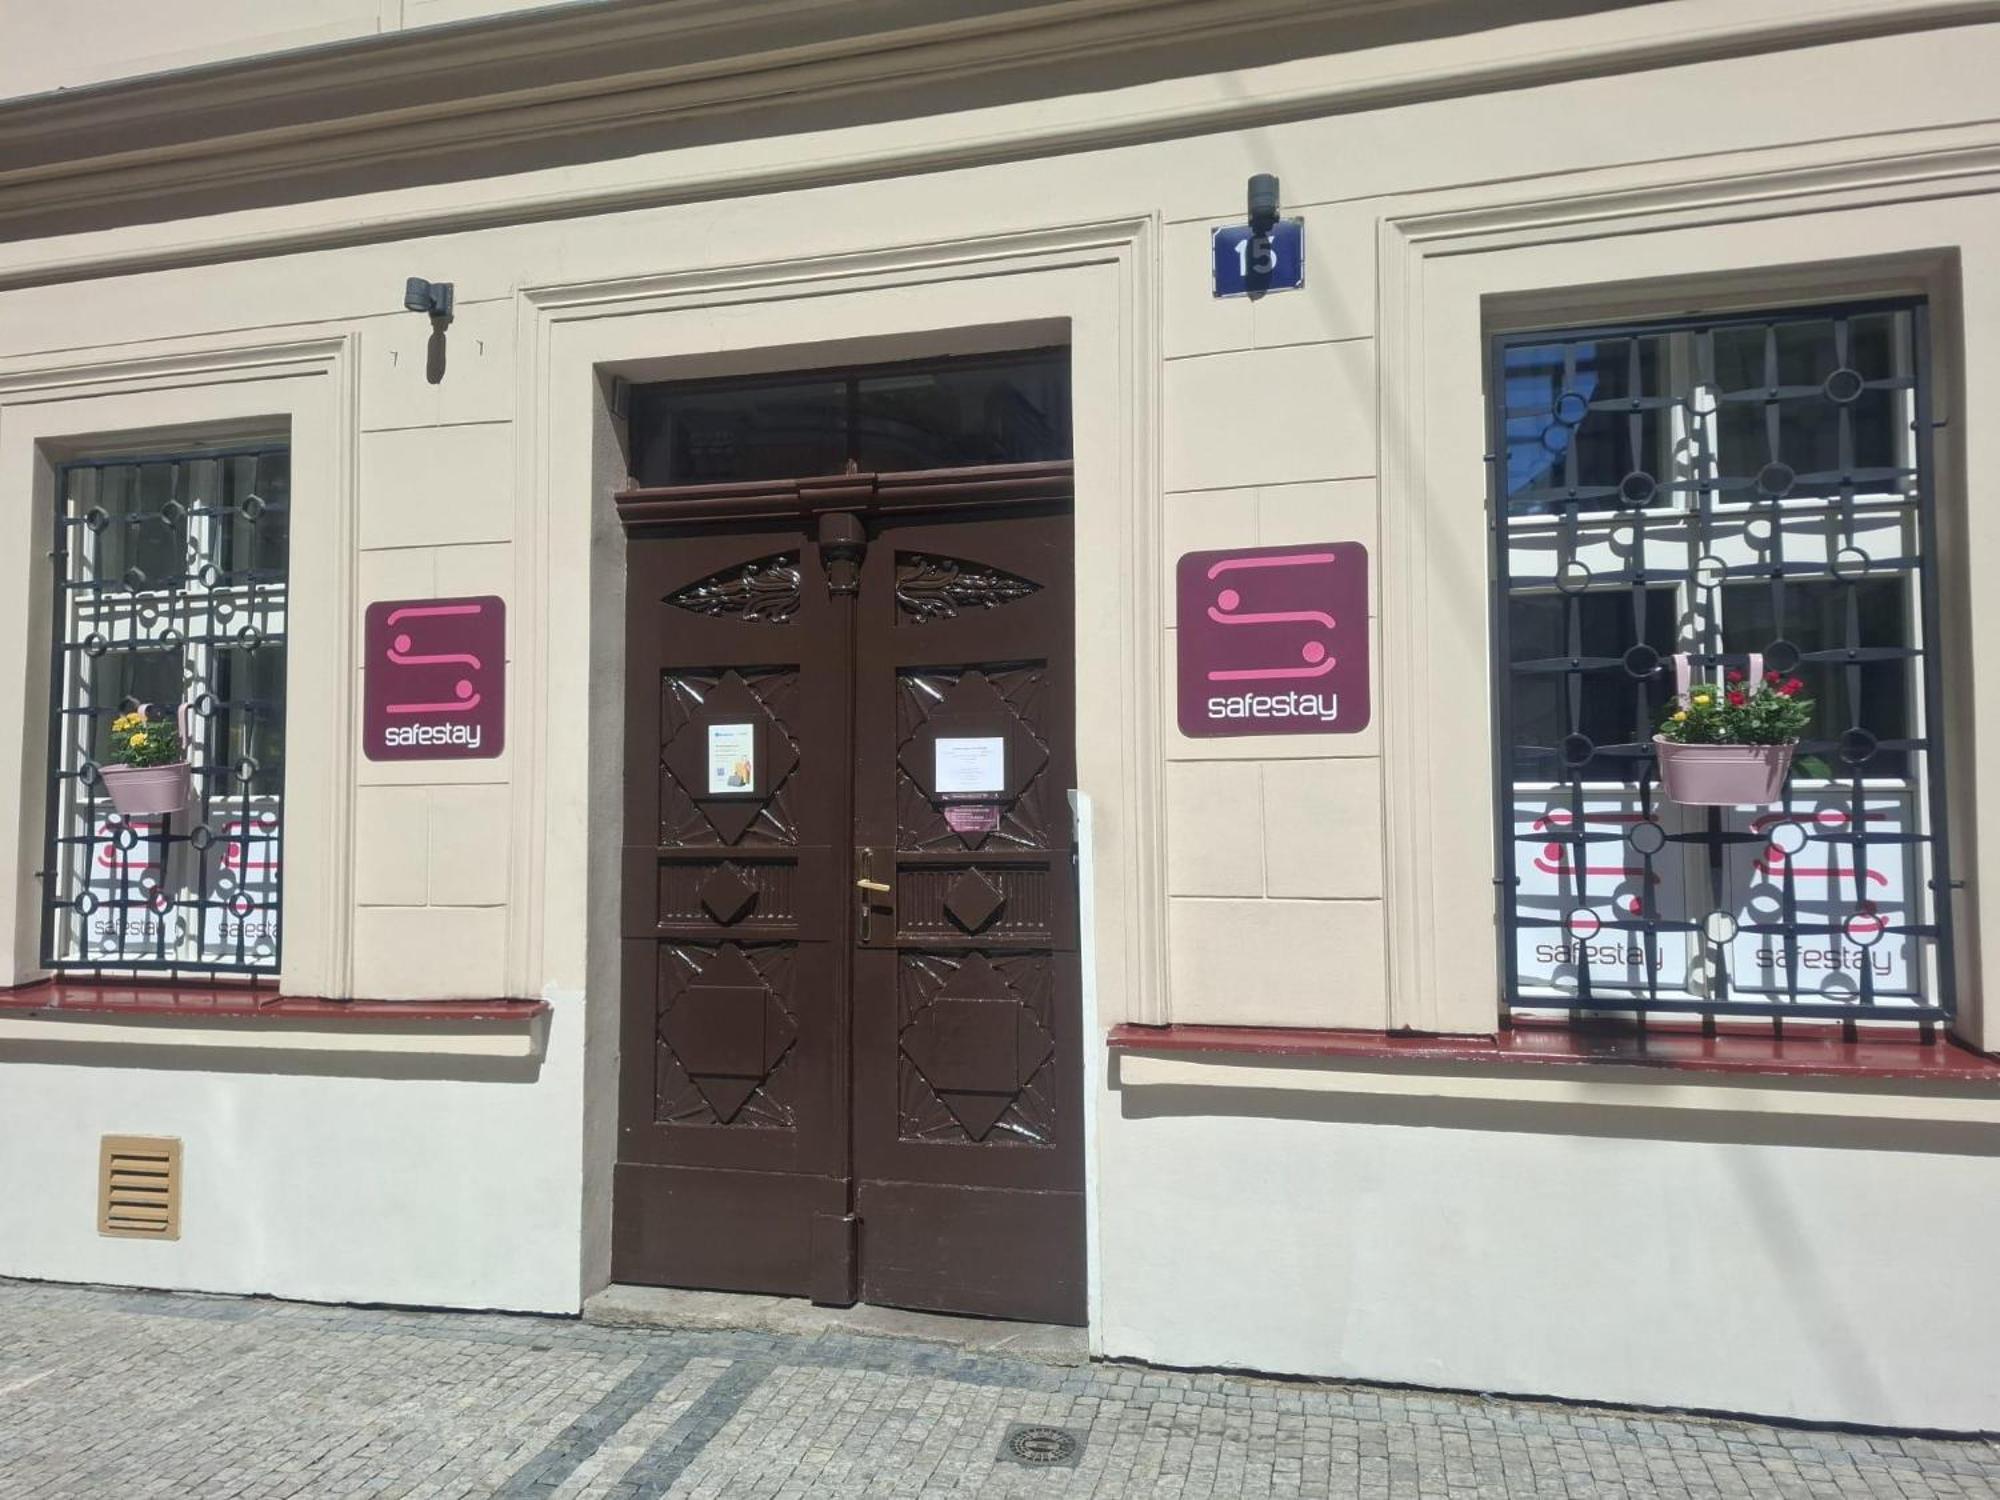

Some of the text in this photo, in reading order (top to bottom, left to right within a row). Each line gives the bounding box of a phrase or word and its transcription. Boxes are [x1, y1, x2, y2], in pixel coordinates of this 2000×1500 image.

[1234, 235, 1278, 277] 15
[1207, 690, 1338, 721] safestay
[385, 722, 481, 748] safestay
[95, 918, 158, 937] safsta
